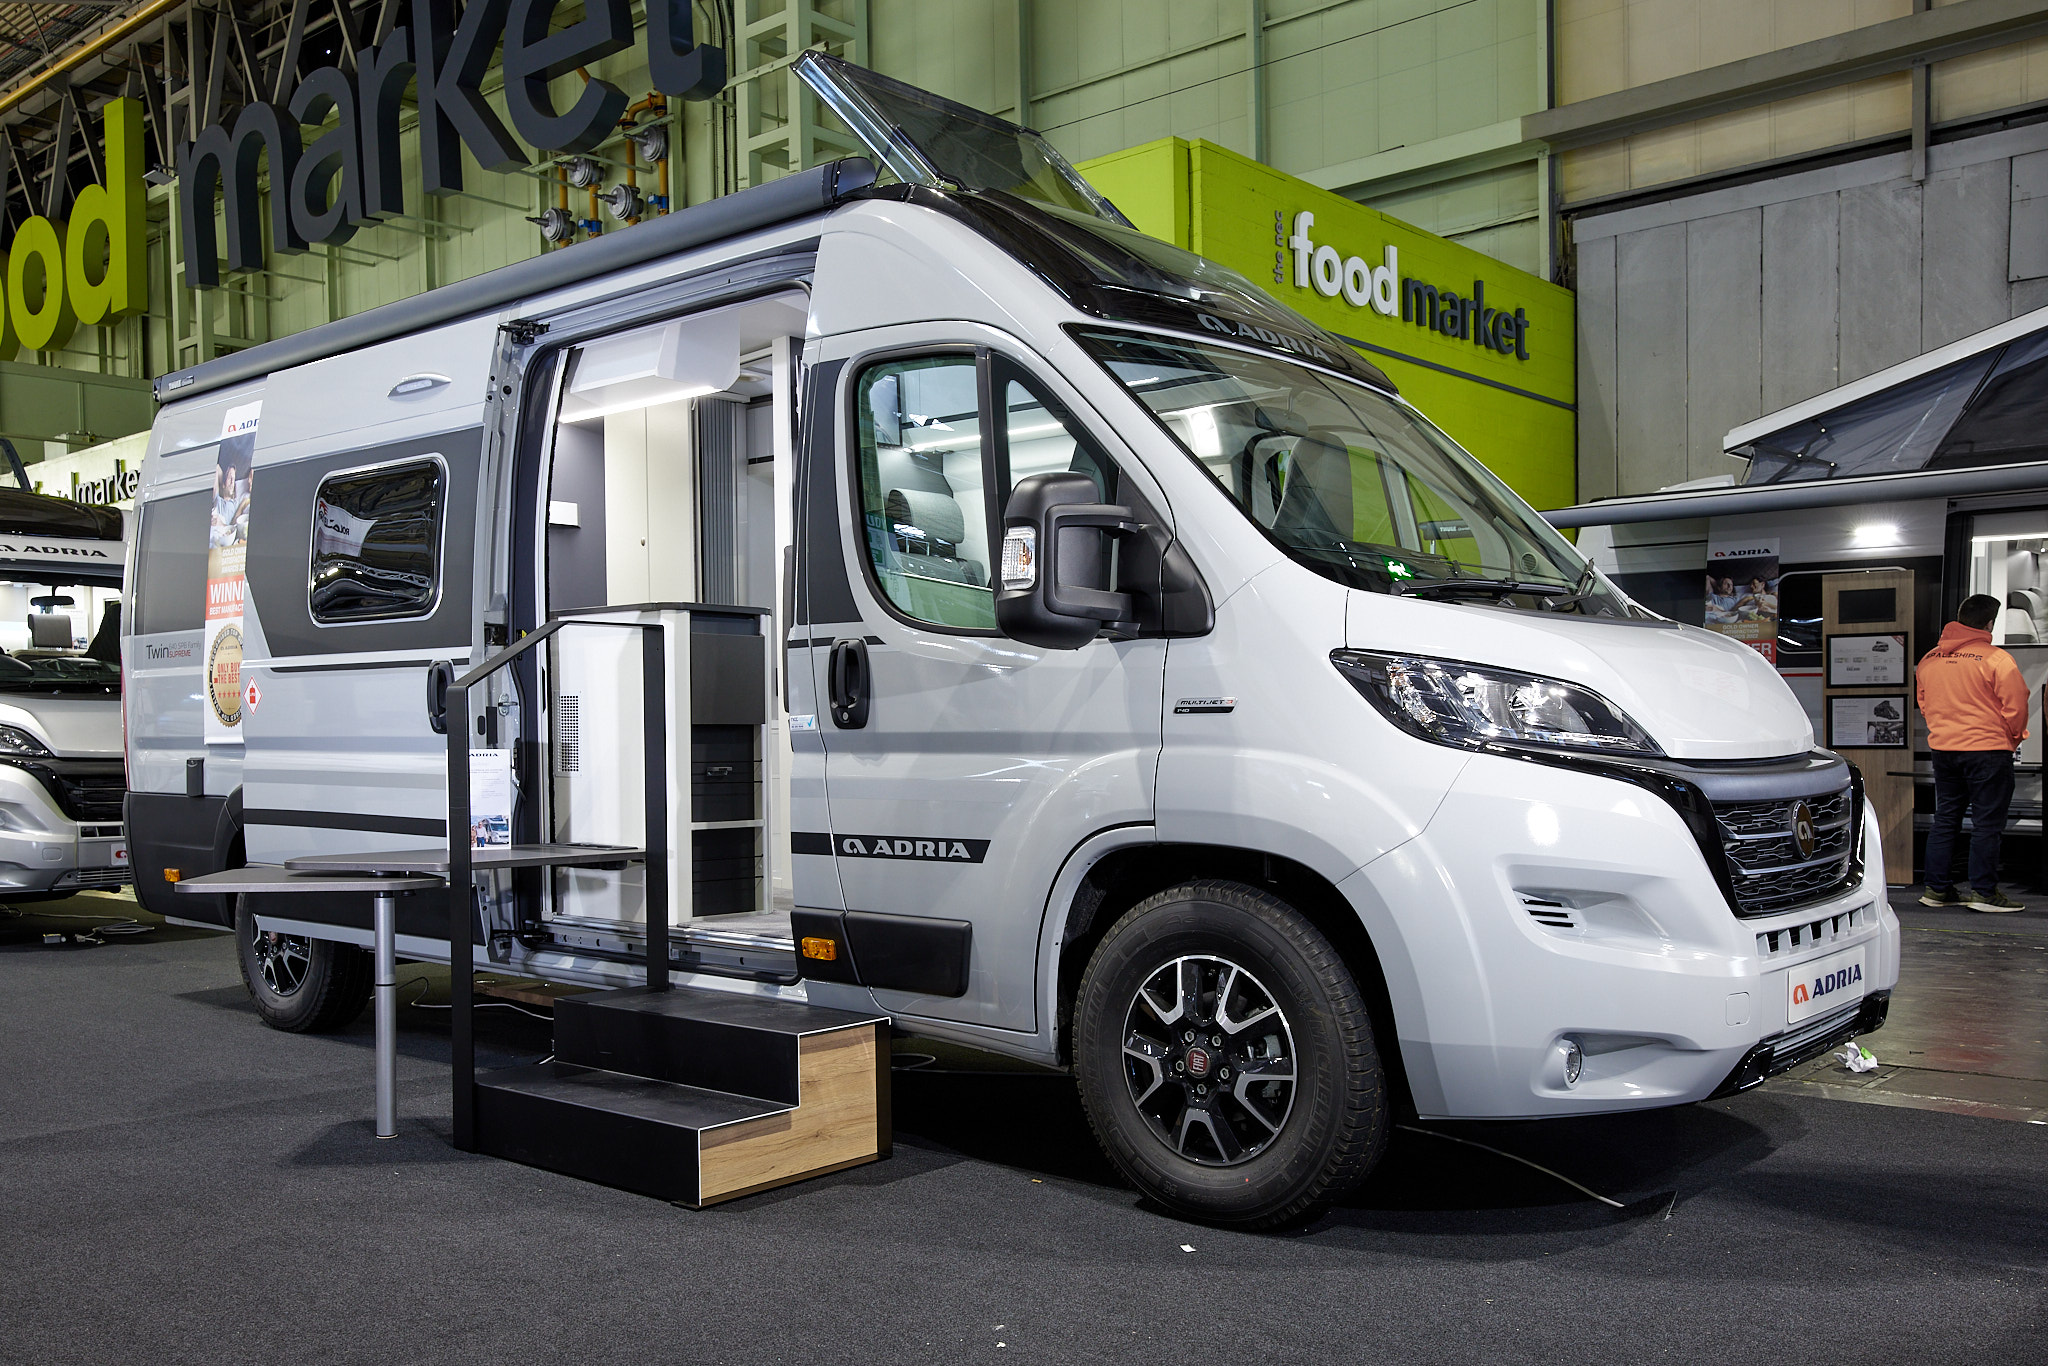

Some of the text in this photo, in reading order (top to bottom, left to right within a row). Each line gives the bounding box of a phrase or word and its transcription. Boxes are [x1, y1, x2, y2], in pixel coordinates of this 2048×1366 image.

[0, 97, 147, 361] od
[1273, 210, 1284, 284] the nec
[1289, 211, 1530, 361] food market
[1236, 321, 1334, 364] ADRIA
[76, 459, 140, 506] marke
[23, 545, 108, 558] ADRIA
[1728, 548, 1771, 557] ADRIA
[209, 605, 221, 616] BEST
[145, 643, 169, 660] Twin
[169, 649, 191, 659] SUPREME
[217, 661, 241, 674] ONLY BUY
[217, 672, 241, 685] THE BEST
[872, 839, 971, 859] ADRIA
[1812, 963, 1862, 1000] ADRIA
[1192, 1052, 1205, 1072] FIAT
